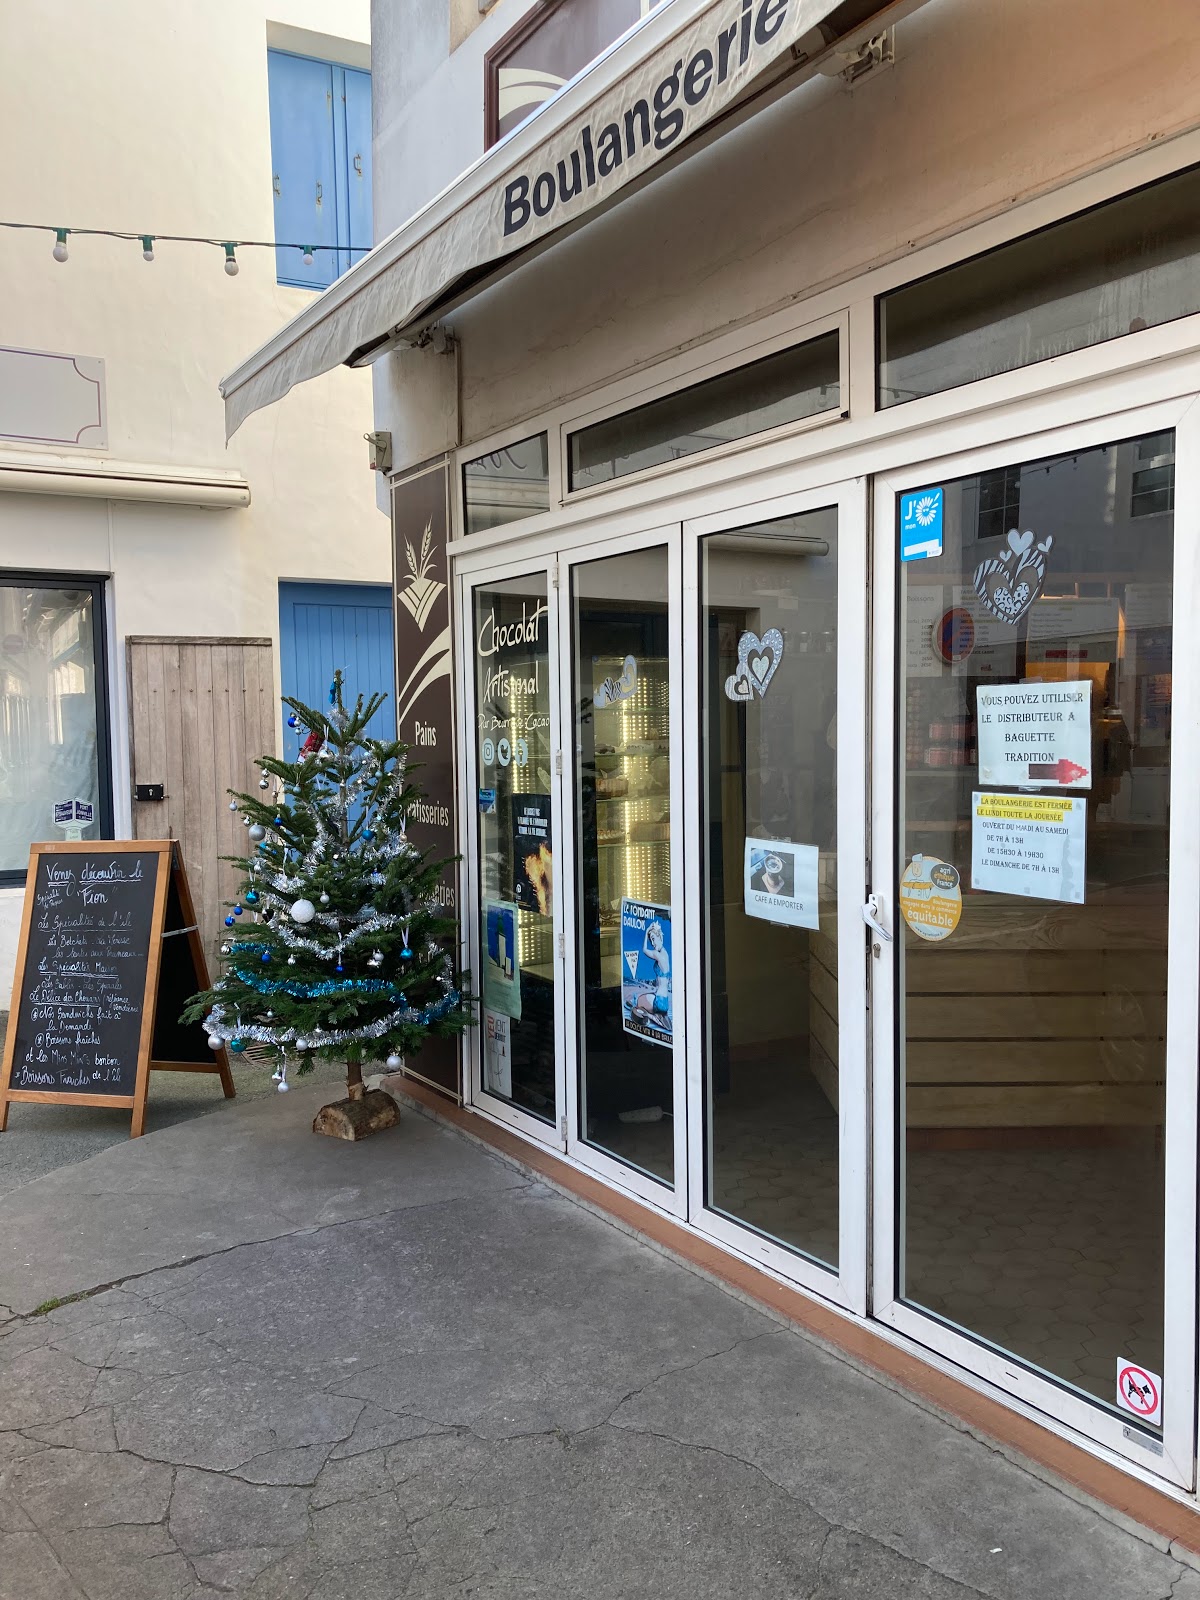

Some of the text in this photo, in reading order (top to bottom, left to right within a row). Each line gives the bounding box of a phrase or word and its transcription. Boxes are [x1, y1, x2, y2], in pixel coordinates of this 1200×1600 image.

[503, 0, 788, 237] Boulangerie
[478, 599, 549, 657] Chocolat
[484, 660, 539, 703] Artisanal
[1004, 694, 1039, 704] POUVEZ
[1042, 693, 1083, 704] UTILISER
[478, 713, 490, 730] Pur
[525, 712, 550, 730] Cacao
[982, 714, 992, 723] LE
[998, 712, 1062, 722] DISTRIBUTEUR
[415, 720, 437, 746] Pains
[1005, 732, 1056, 742] BAGUETTE
[1005, 752, 1054, 762] TRADITION
[990, 798, 1032, 808] BOULANGERIE
[1048, 802, 1072, 810] FERMÉE
[1046, 826, 1068, 835] SAMEDI
[990, 860, 1020, 870] DIMANCHE
[46, 860, 143, 896] Venez découvrir le
[755, 895, 767, 904] CAFE
[774, 899, 804, 910] EMPORTER
[908, 908, 952, 926] équitable
